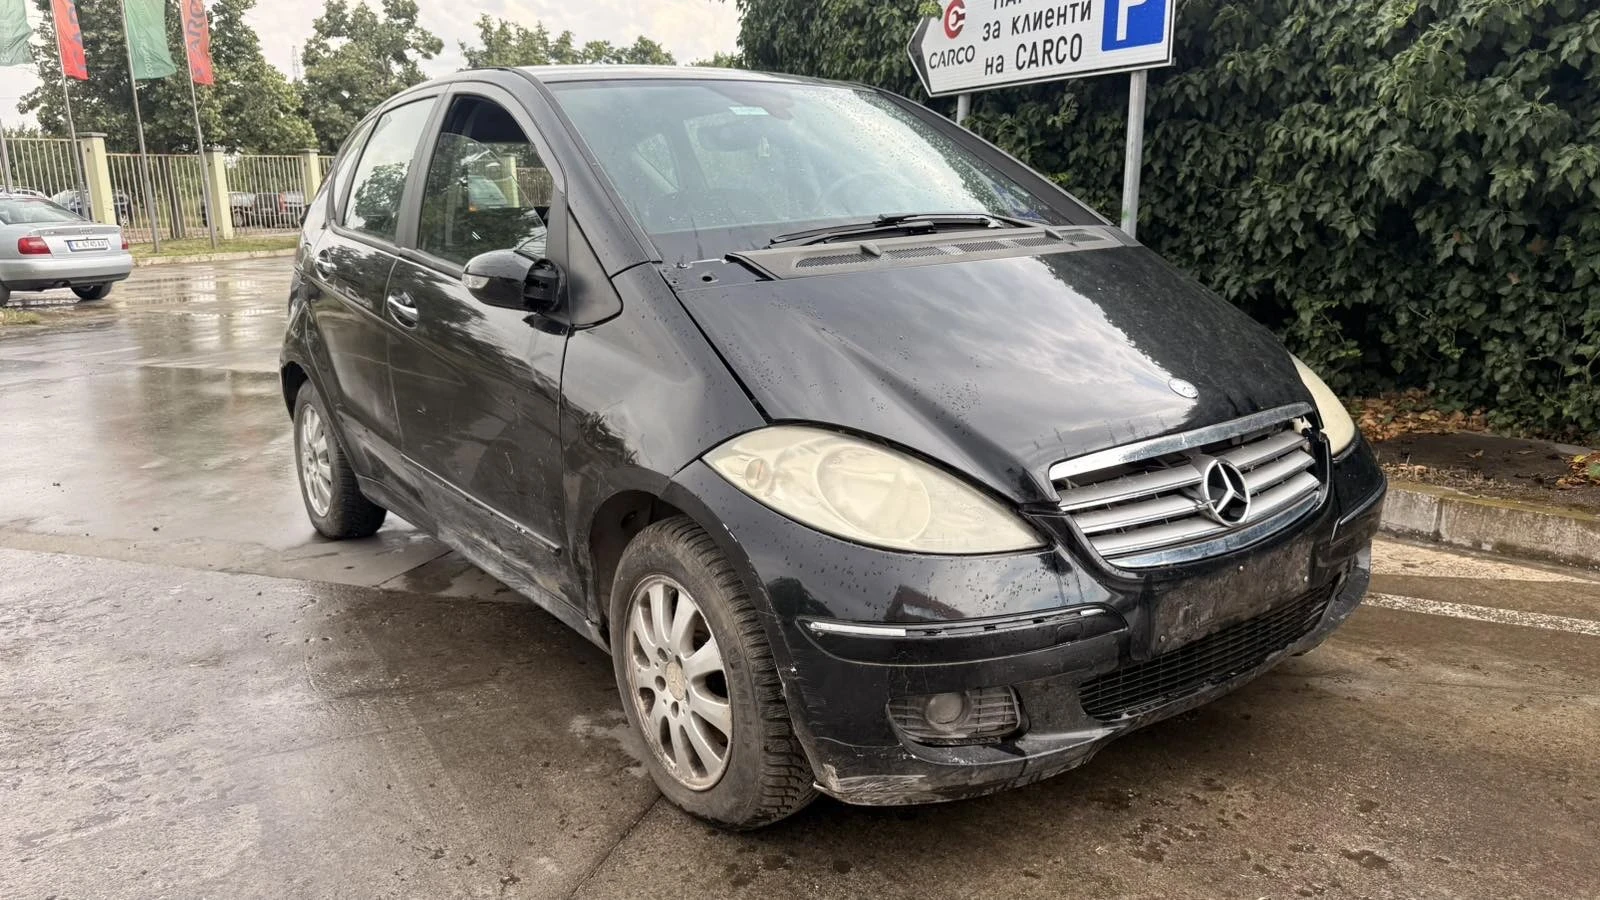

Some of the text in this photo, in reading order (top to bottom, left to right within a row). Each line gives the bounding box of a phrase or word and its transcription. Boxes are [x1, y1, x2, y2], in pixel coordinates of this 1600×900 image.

[982, 0, 1092, 42] за клиенти
[929, 45, 976, 70] CARCO
[984, 33, 1083, 76] на CARCO
